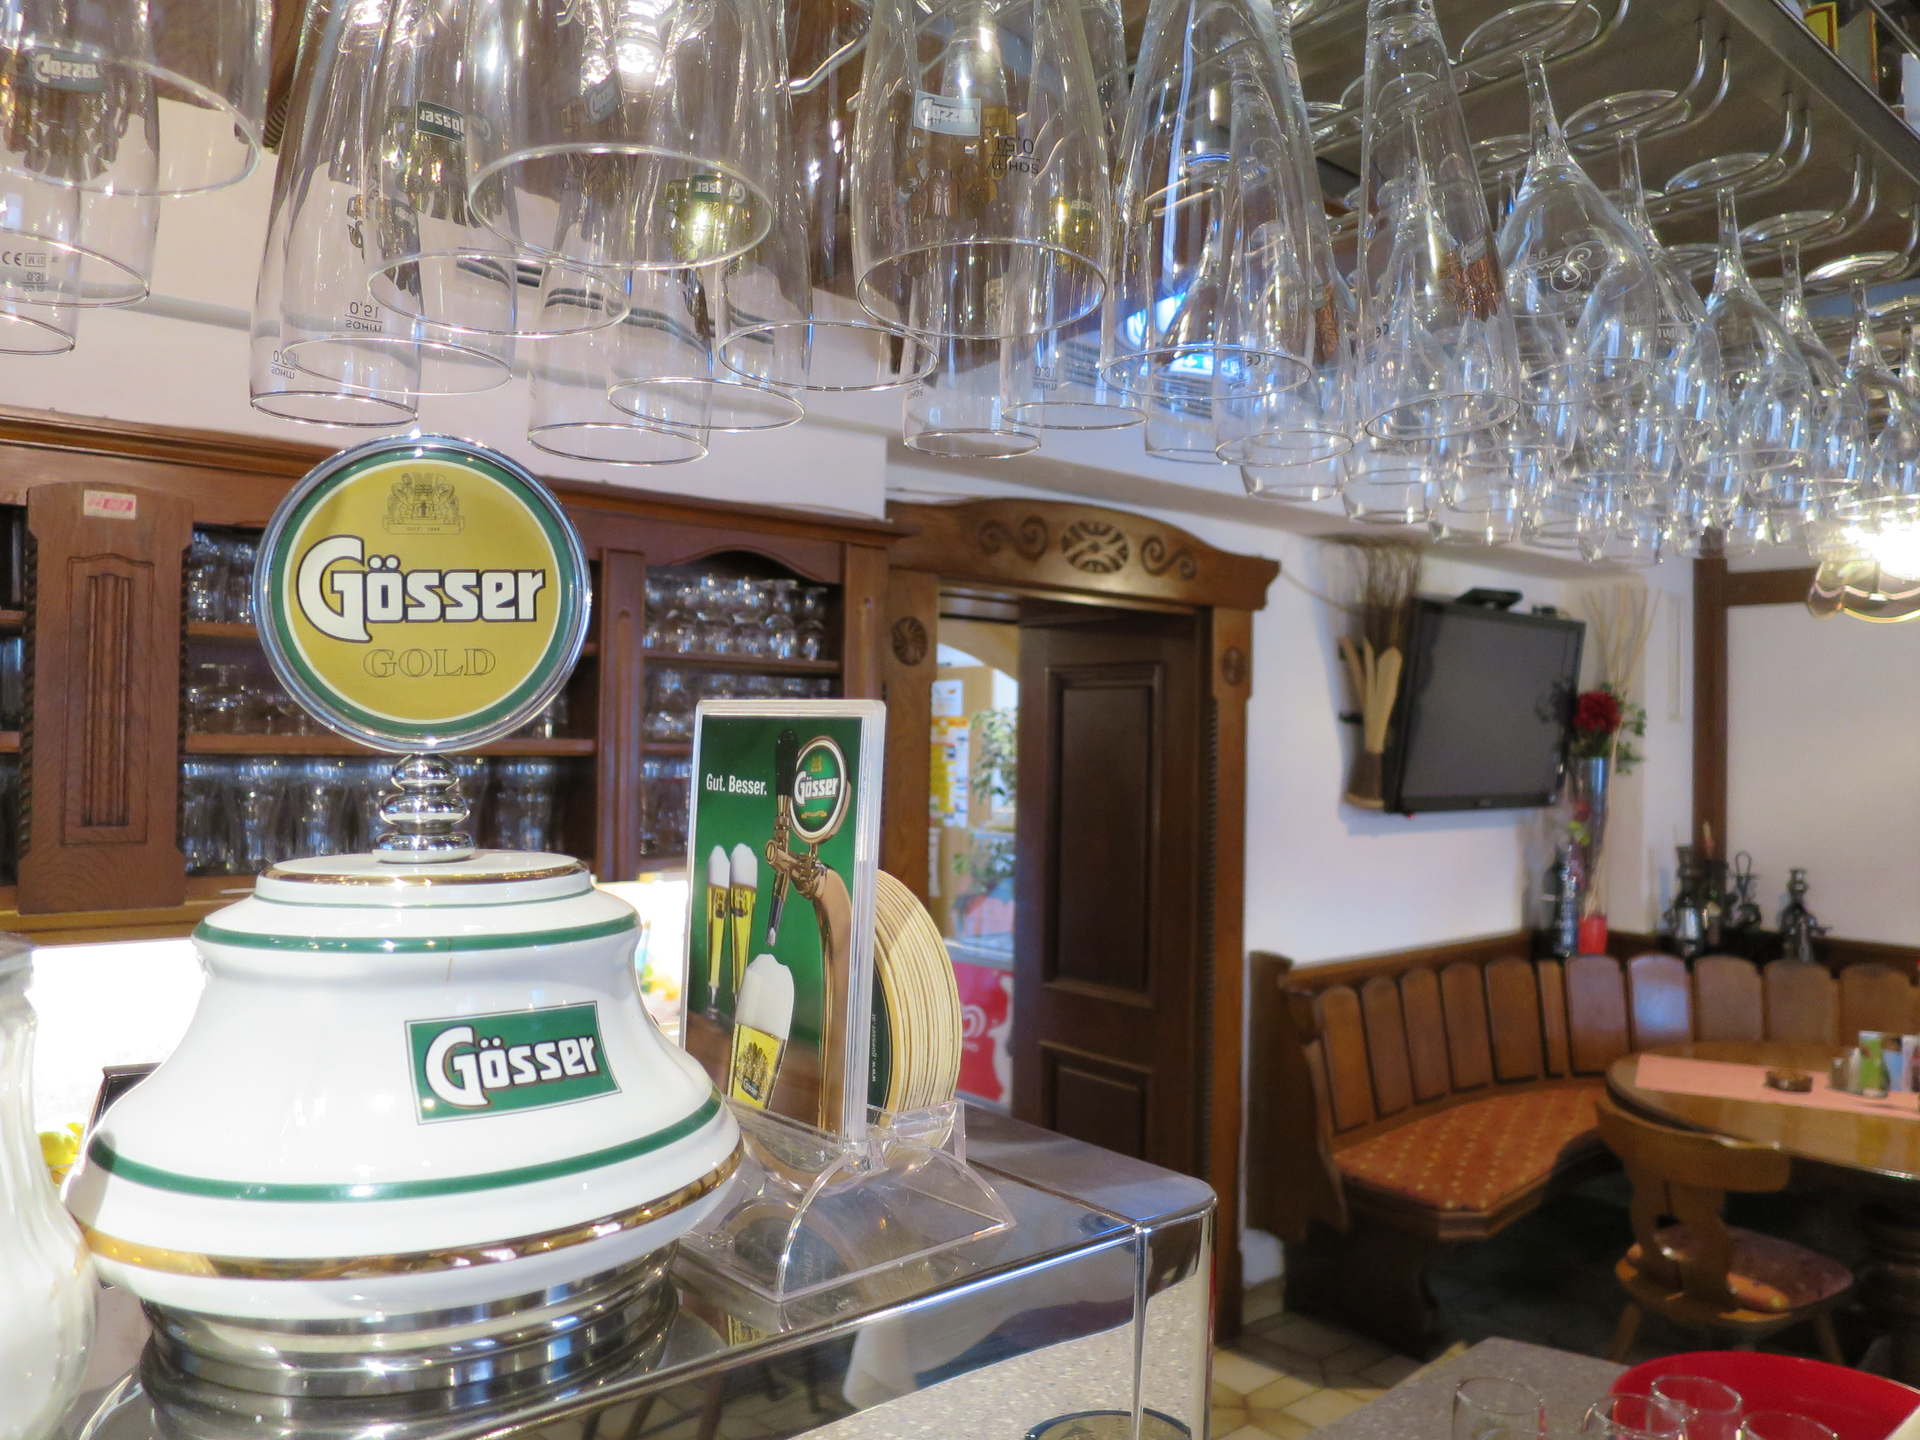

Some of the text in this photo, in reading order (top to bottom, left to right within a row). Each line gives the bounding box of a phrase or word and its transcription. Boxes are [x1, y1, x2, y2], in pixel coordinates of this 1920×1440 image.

[296, 534, 546, 643] Gösser
[363, 648, 496, 678] GOLD
[706, 773, 768, 796] Gut. Besser.
[794, 770, 839, 806] Gösser
[424, 1025, 600, 1108] Gösser
